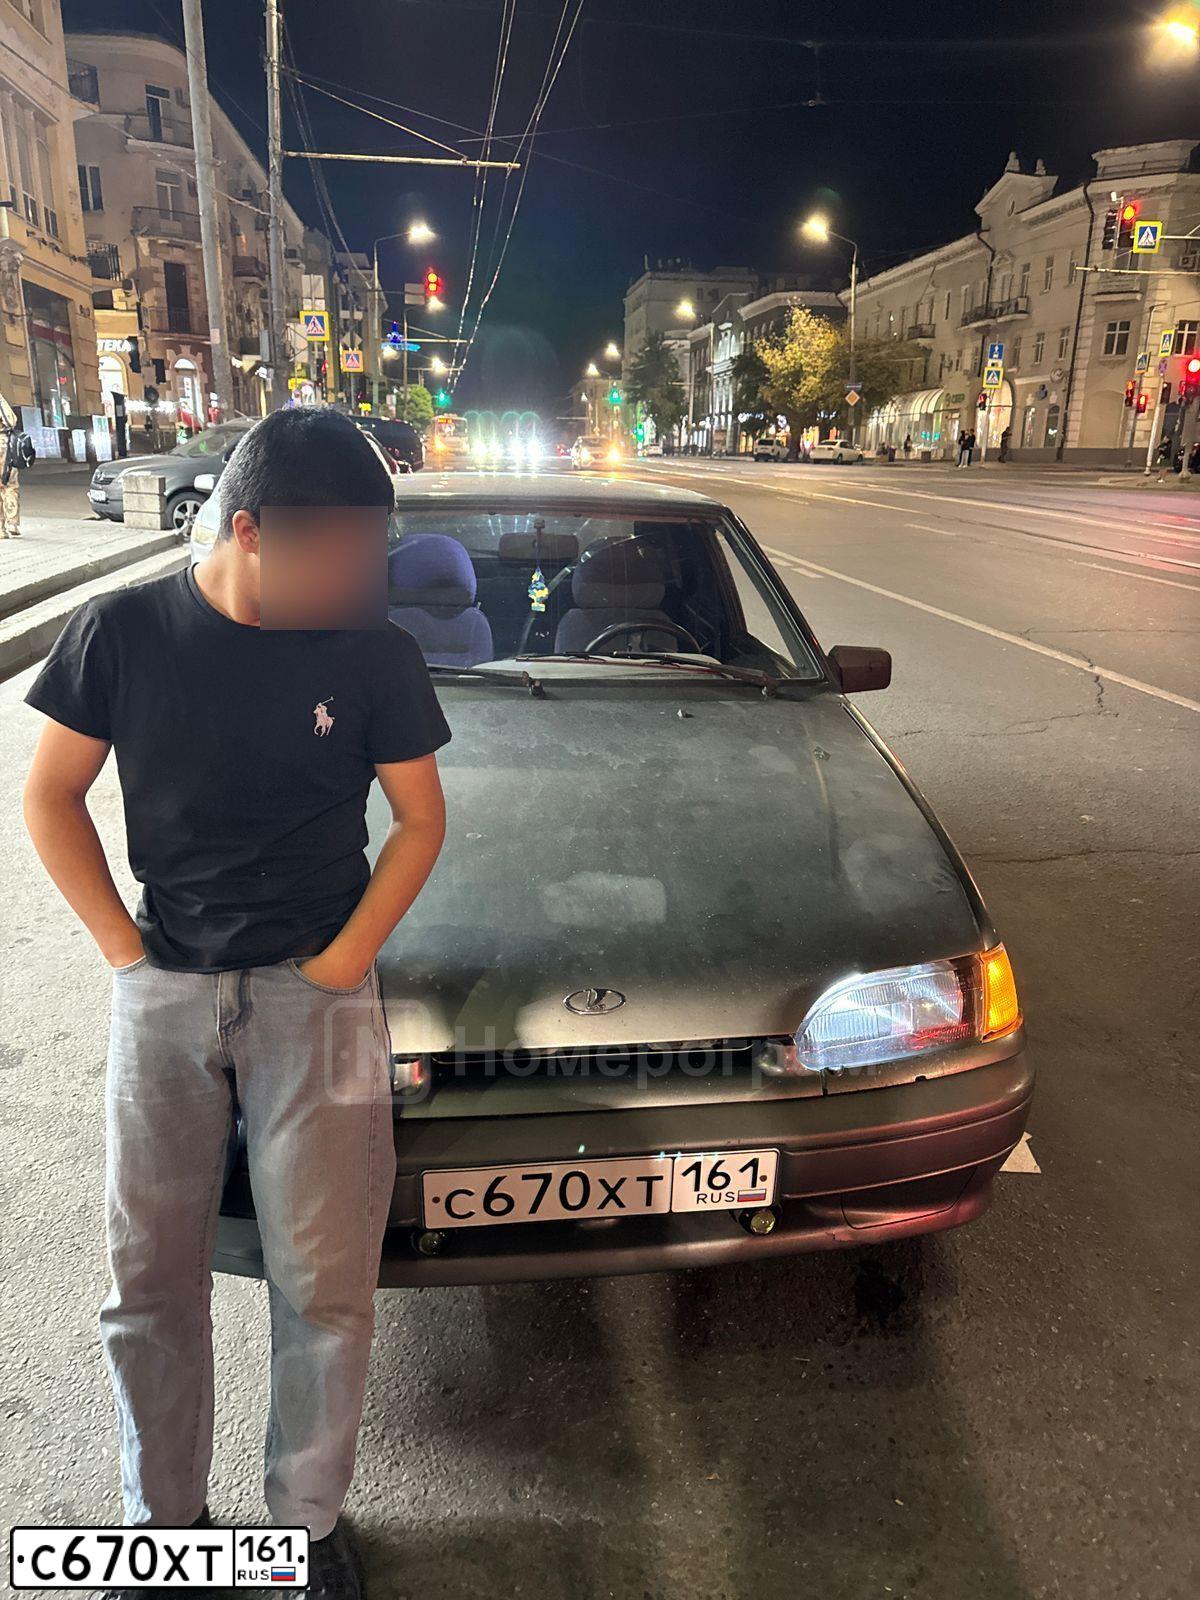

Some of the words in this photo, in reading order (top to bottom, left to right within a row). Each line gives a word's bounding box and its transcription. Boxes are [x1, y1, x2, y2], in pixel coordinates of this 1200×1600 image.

[444, 1170, 663, 1220] С670ХТ
[681, 1157, 760, 1192] 161
[696, 1191, 736, 1205] RUS
